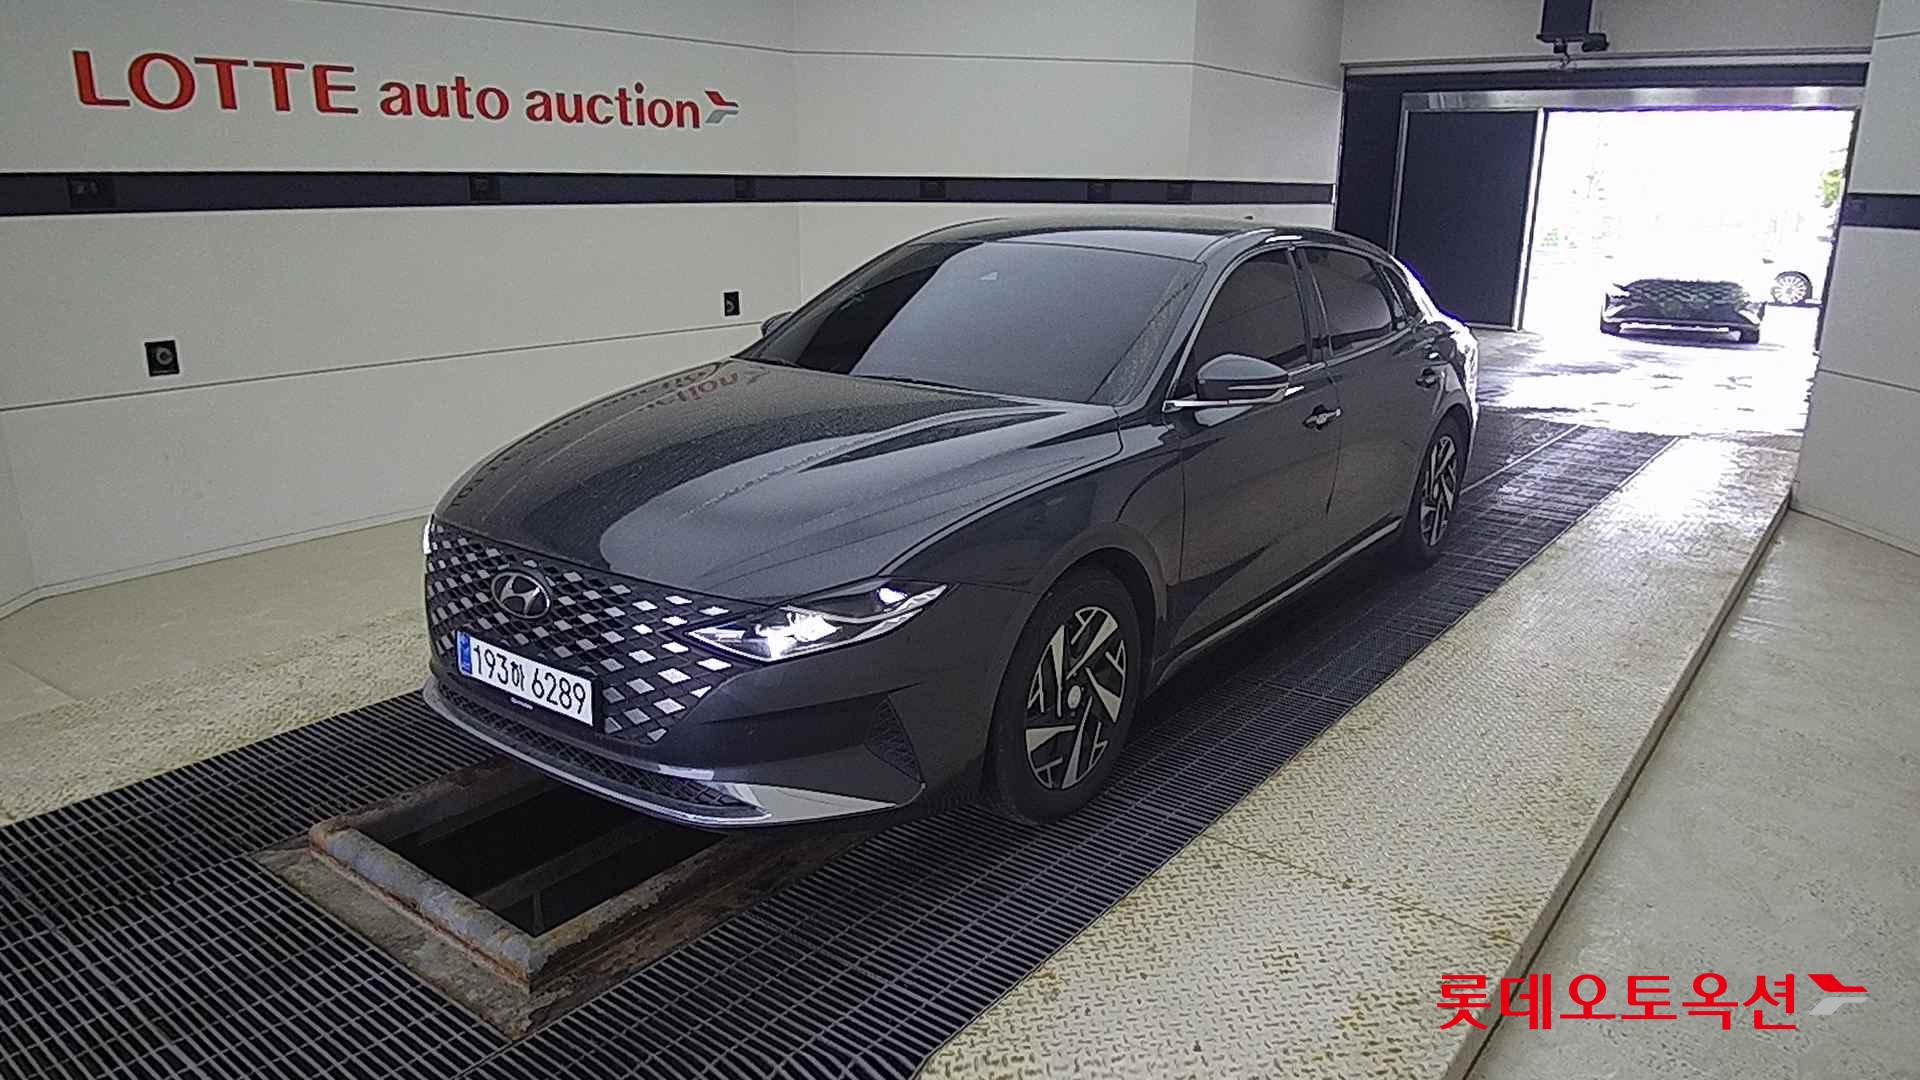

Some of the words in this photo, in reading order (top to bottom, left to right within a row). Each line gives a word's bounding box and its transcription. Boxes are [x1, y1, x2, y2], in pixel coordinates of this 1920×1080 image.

[72, 50, 359, 114] LOTTE
[380, 76, 510, 120] auto
[526, 82, 700, 128] auction
[473, 645, 525, 691] 193하
[531, 668, 586, 714] 6289
